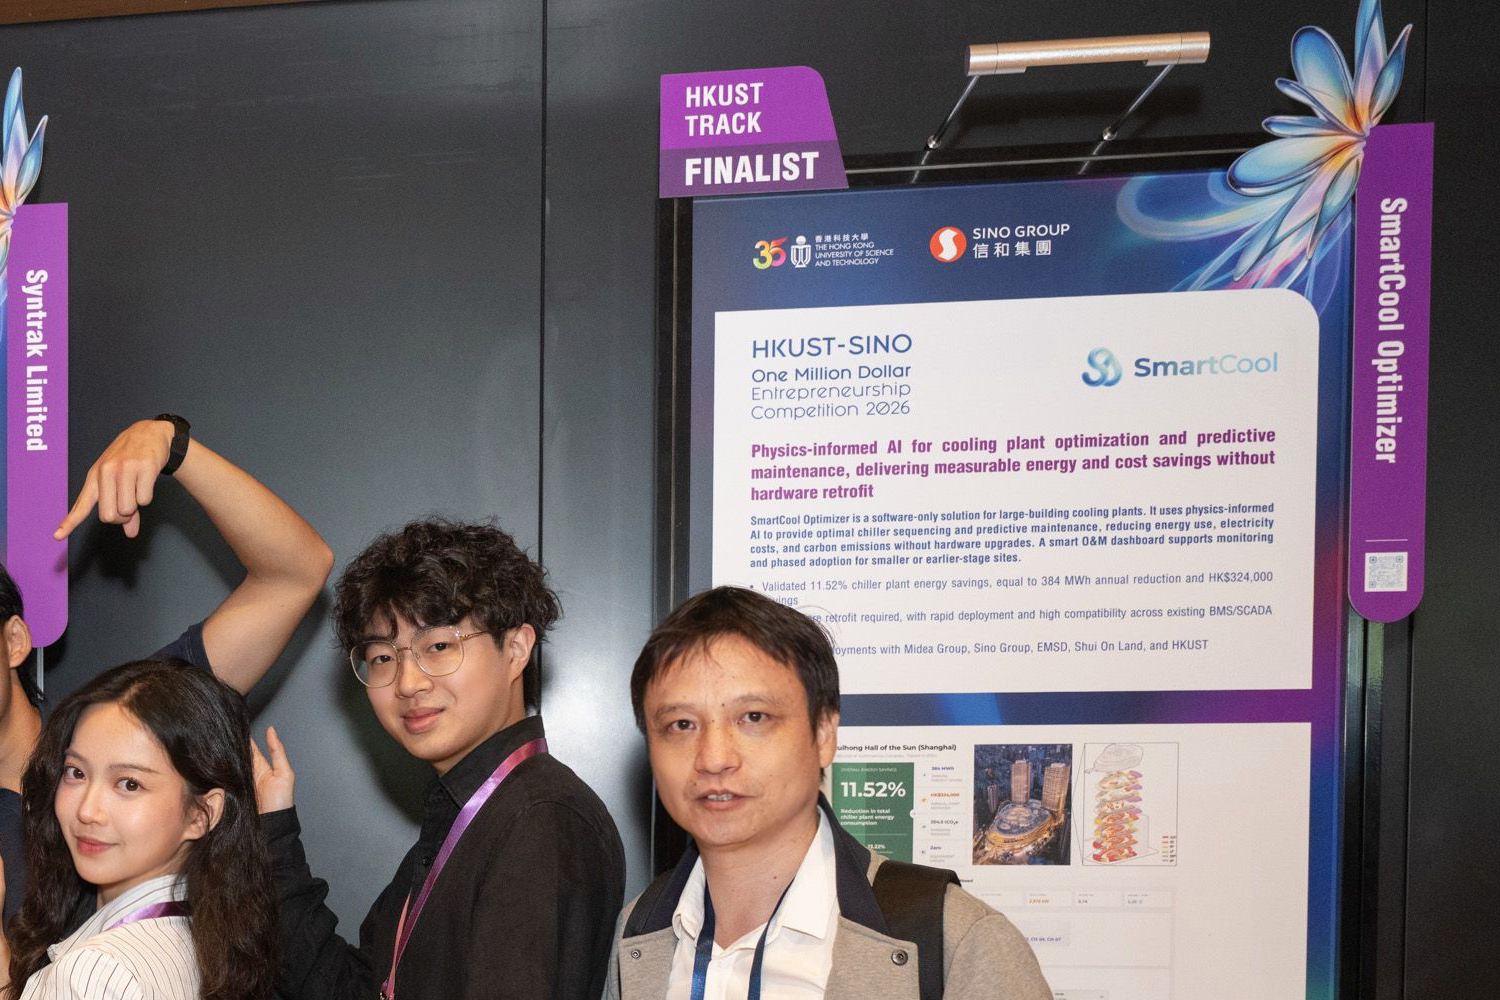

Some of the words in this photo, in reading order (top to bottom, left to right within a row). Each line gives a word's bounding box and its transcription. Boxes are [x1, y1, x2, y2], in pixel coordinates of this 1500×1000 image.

[686, 82, 764, 108] HKUST
[684, 111, 761, 136] TRACK
[685, 151, 819, 185] FINALIST
[972, 226, 1011, 240] SINO
[1014, 223, 1070, 237] GROUP
[815, 251, 852, 259] UNIVERSITY
[972, 239, 1051, 258] 信和集團
[832, 258, 879, 266] TECHNOLOGY
[1378, 198, 1408, 330] SmartCool
[22, 270, 48, 358] Syntrak
[752, 334, 912, 358] HKUST-SINO
[751, 369, 788, 383] One
[795, 366, 851, 381] Million
[858, 364, 911, 379] Dollar
[1134, 352, 1278, 377] SmartCool
[751, 382, 911, 401] Entrepreneurship
[1371, 340, 1404, 464] Optimizer
[26, 366, 48, 450] Limited
[750, 403, 859, 420] Competition
[866, 400, 910, 416] 2026
[751, 441, 877, 460] Physics-informed
[887, 439, 902, 454] AI
[911, 439, 932, 453] for
[942, 437, 997, 454] cooling
[1006, 435, 1045, 453] plant
[1055, 432, 1149, 451] optimization
[1159, 430, 1187, 445] and
[1197, 428, 1276, 447] predictive
[751, 465, 850, 479] maintenance,
[855, 461, 929, 477] delivering
[934, 458, 1021, 474] measurable
[1026, 459, 1077, 474] energy
[1081, 455, 1109, 470] and
[1115, 454, 1148, 469] cost
[1152, 453, 1211, 469] savings
[1216, 450, 1275, 466] without
[751, 486, 818, 500] hardware
[822, 484, 874, 499] retrofit
[750, 515, 800, 526] SmartCool
[803, 514, 850, 526] Optimizer
[852, 513, 861, 523] is
[863, 514, 869, 523] a
[871, 512, 938, 523] software-only
[940, 510, 980, 521] solution
[982, 510, 997, 520] for
[999, 508, 1069, 521] large-building
[1072, 507, 1109, 519] cooling
[1111, 506, 1146, 518] plants.
[1149, 505, 1156, 516] It
[1159, 506, 1183, 515] uses
[1185, 503, 1274, 516] physics-informed
[840, 782, 906, 798] 11.52%
